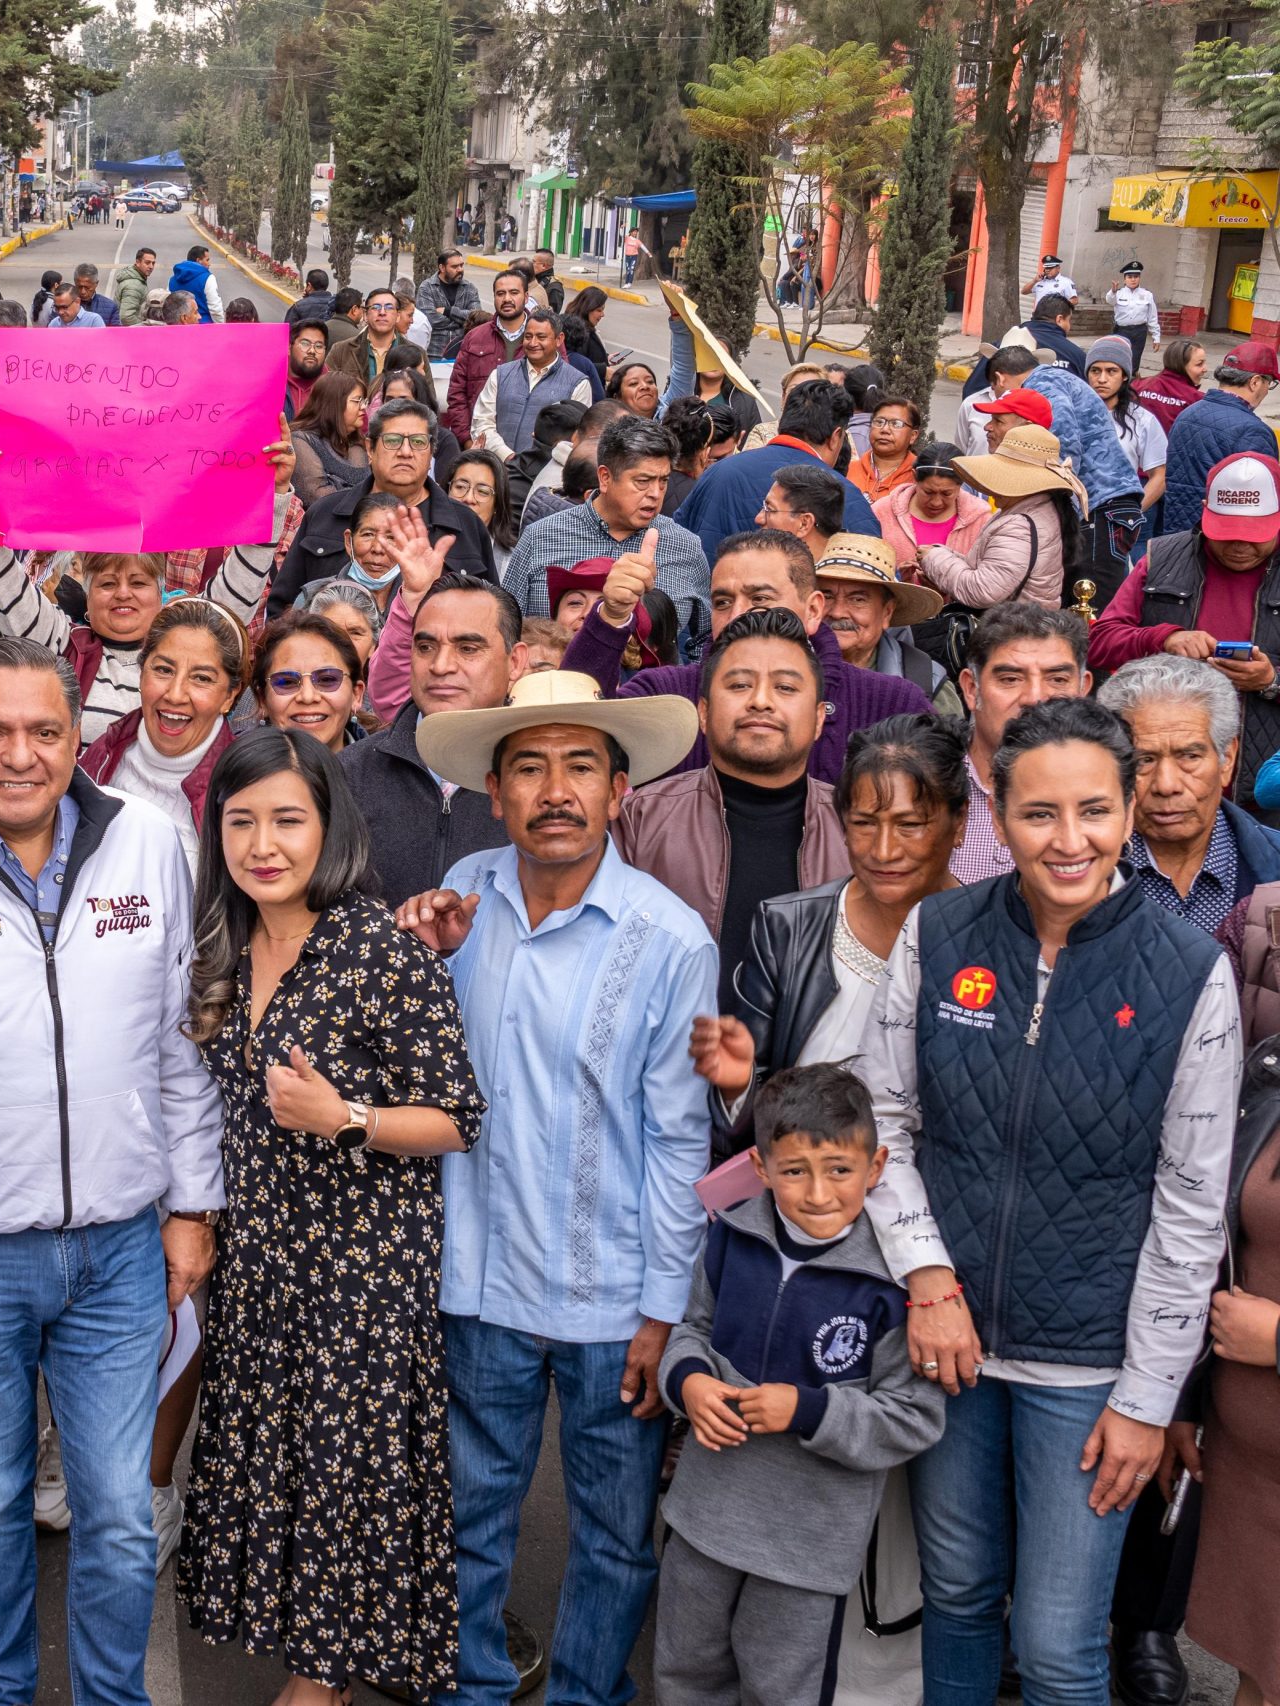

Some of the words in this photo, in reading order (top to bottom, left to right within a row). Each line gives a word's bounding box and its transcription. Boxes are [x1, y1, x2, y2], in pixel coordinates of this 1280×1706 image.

[1209, 193, 1261, 211] POLO
[1218, 214, 1249, 224] Fresco
[1217, 489, 1261, 498] RICARDO
[1217, 497, 1261, 505] MORENO
[86, 894, 151, 914] TOLUCA
[95, 914, 152, 939] guapa
[957, 978, 992, 1005] PT
[939, 1001, 964, 1014] ESTADO
[963, 1009, 974, 1017] DE
[1148, 1307, 1191, 1330] Tommy
[830, 1315, 847, 1327] JOSE
[854, 1342, 866, 1357] SAN
